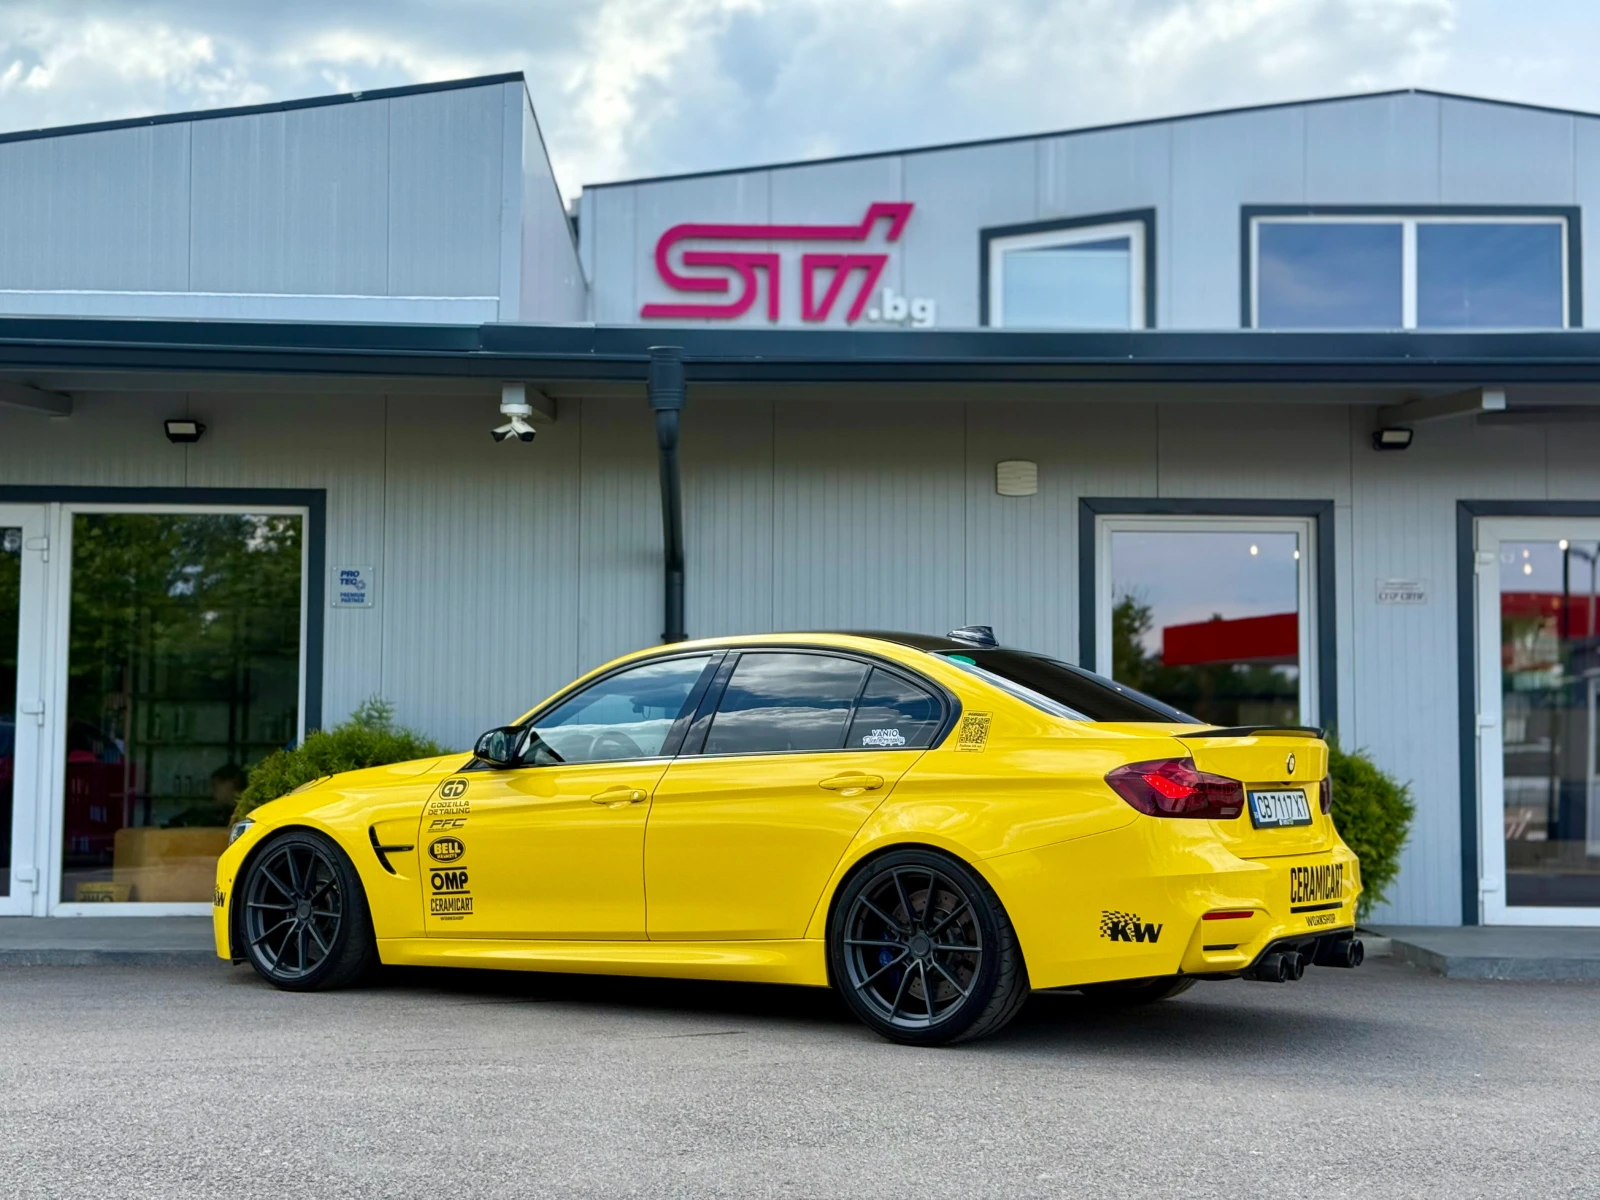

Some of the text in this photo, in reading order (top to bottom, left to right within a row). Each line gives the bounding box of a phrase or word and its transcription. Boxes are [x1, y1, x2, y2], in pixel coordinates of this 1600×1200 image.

[340, 570, 360, 578] PRO
[441, 780, 468, 797] GD
[428, 807, 471, 816] DETAILING
[1270, 795, 1294, 819] 7117
[429, 818, 468, 828] PFC
[433, 842, 461, 854] BELL
[431, 871, 469, 890] OMP
[1290, 863, 1343, 903] CERAMICART
[430, 897, 473, 912] CERAMICART
[1305, 913, 1336, 927] WORKSHOP
[1109, 919, 1164, 943] KW
